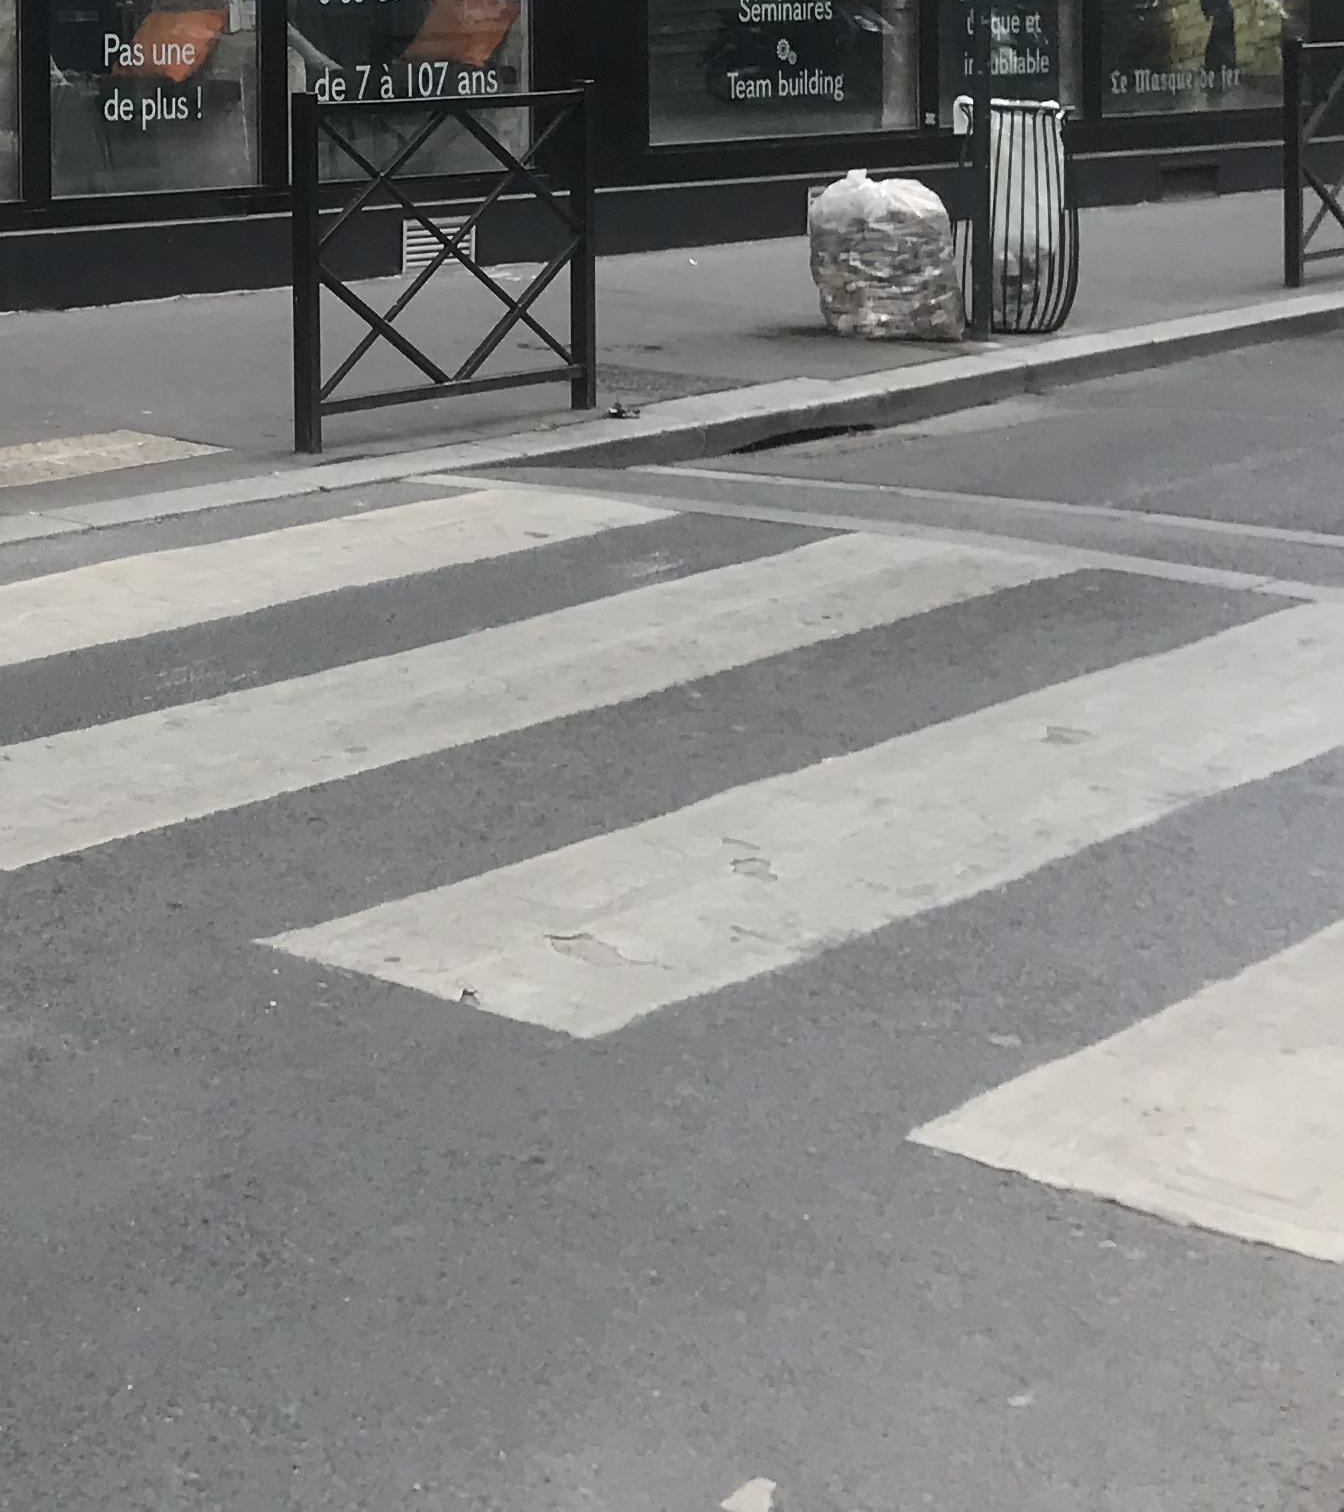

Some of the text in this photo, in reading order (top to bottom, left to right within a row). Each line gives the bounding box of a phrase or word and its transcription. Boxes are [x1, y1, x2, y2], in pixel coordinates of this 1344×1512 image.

[104, 34, 195, 68] Pas une
[315, 61, 499, 102] de 7 à 107 ans
[727, 68, 844, 101] Team building
[105, 88, 204, 130] de plus !
